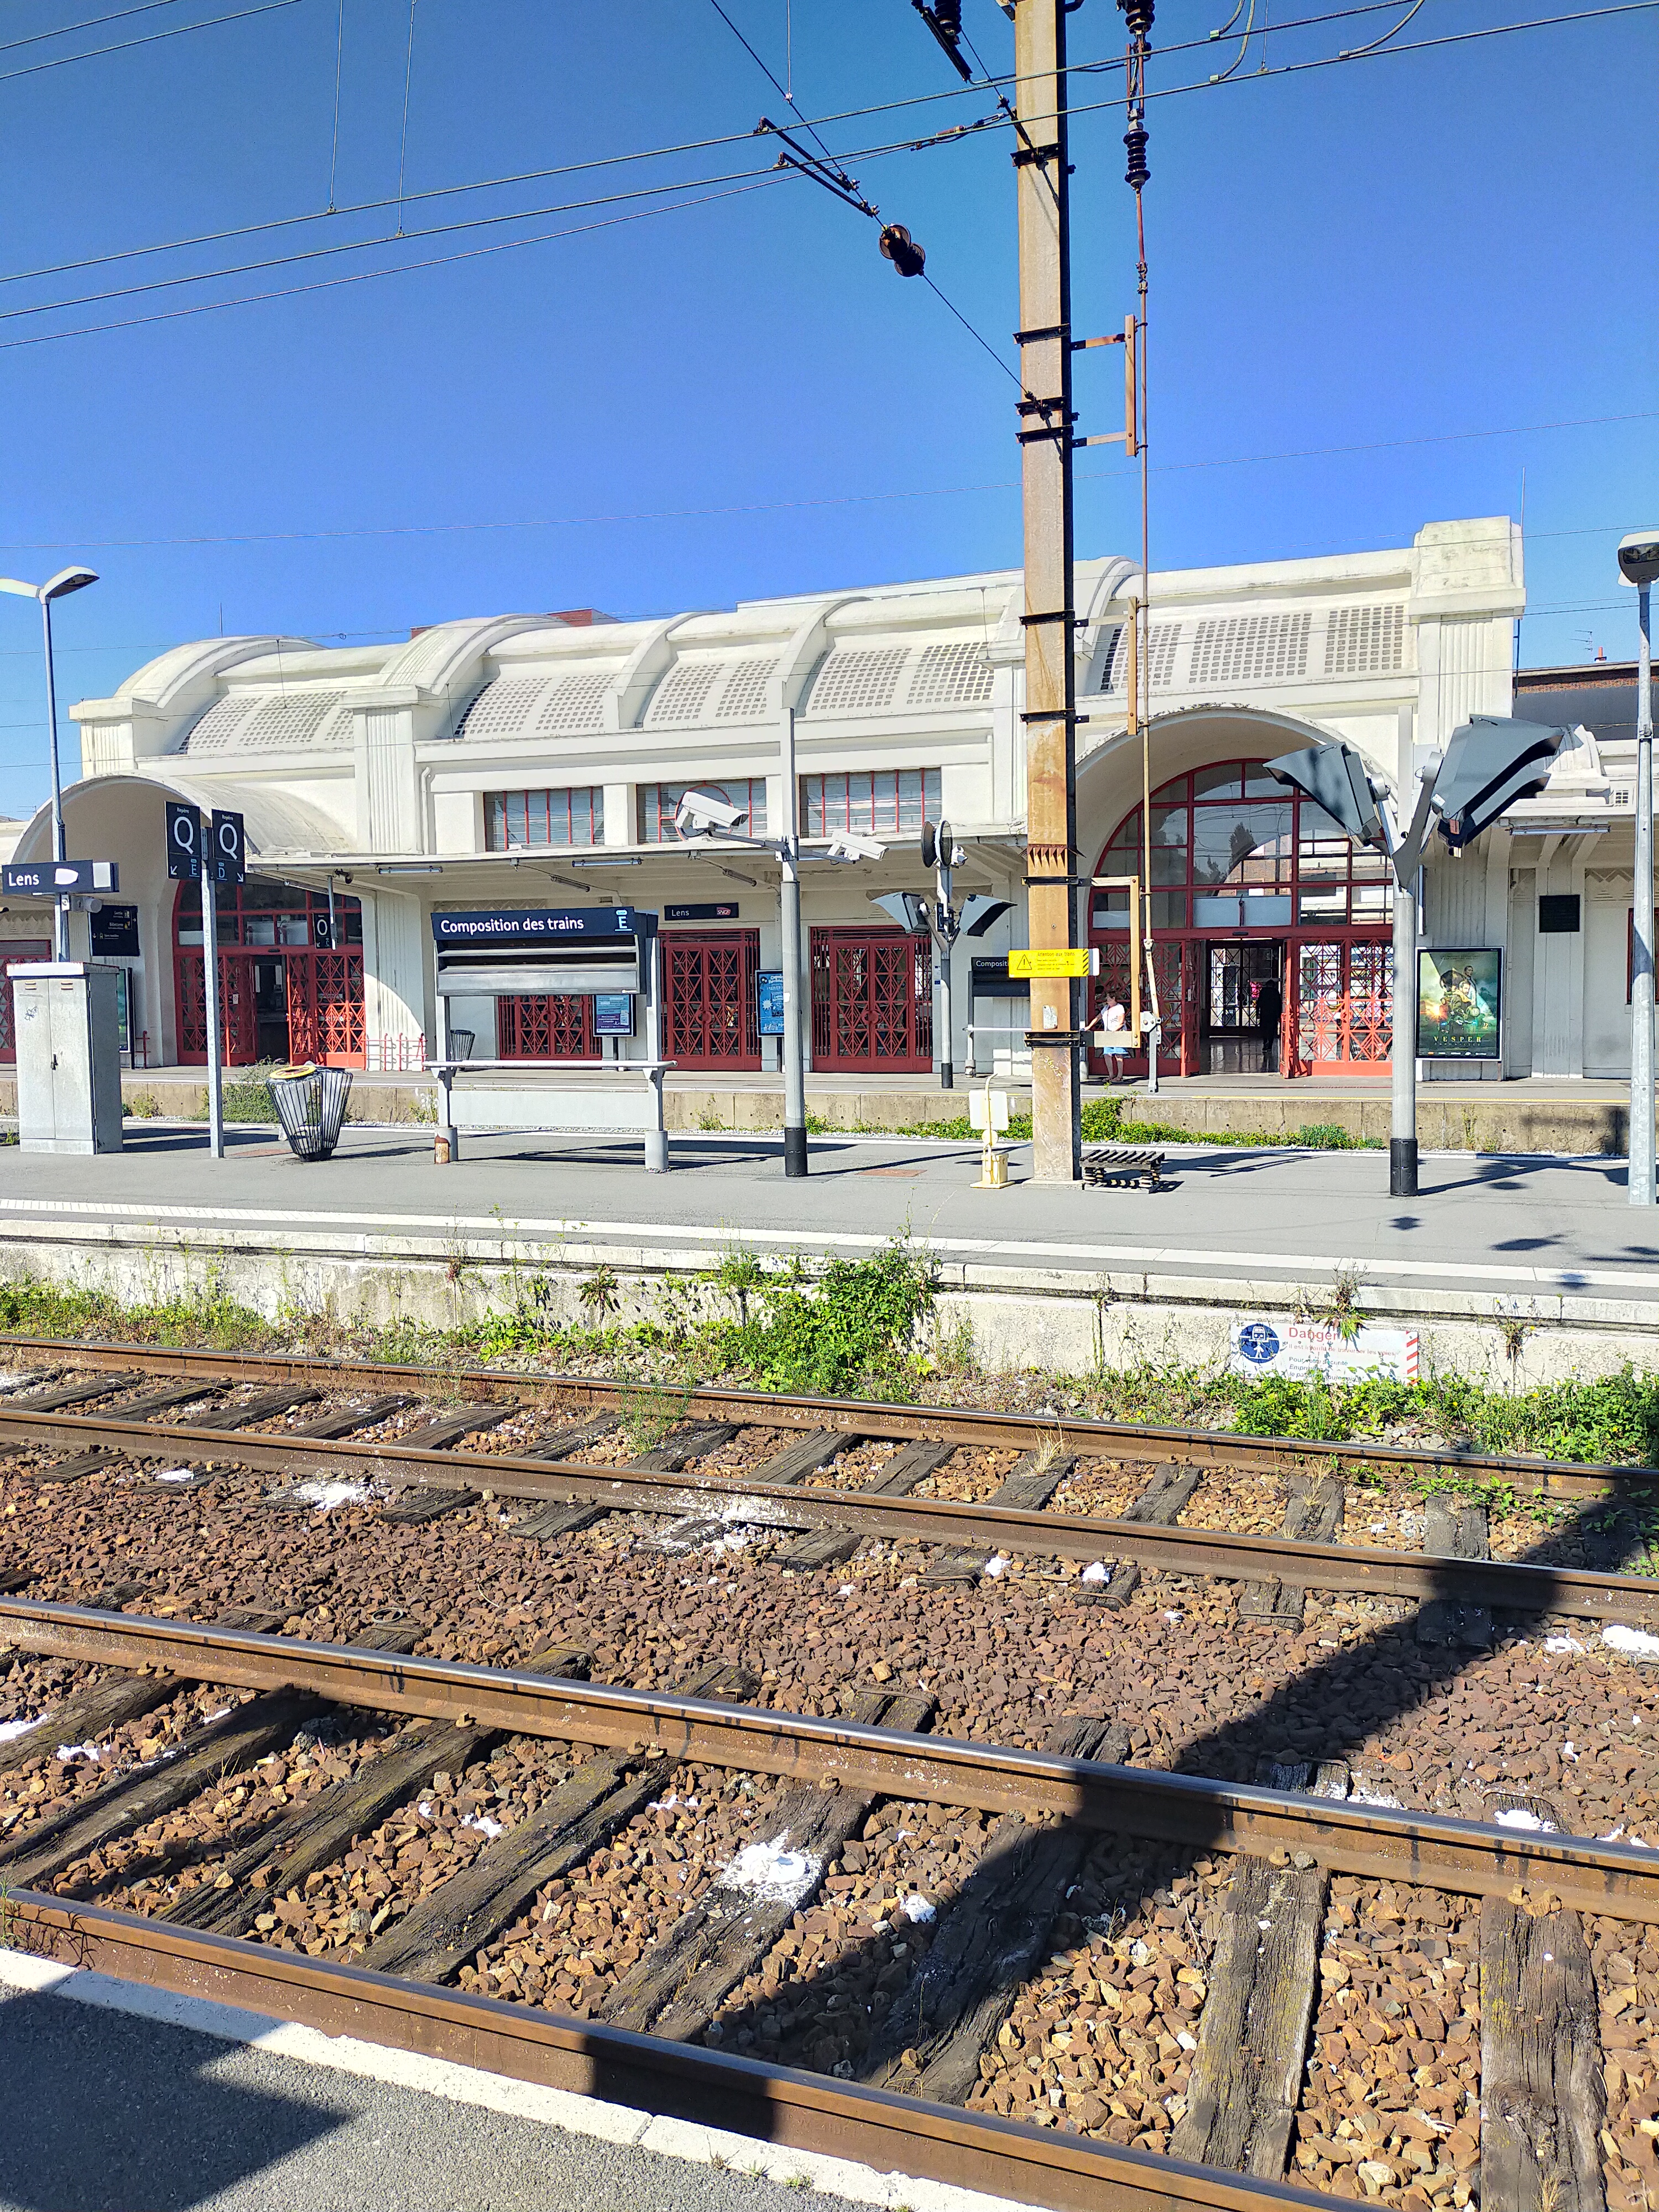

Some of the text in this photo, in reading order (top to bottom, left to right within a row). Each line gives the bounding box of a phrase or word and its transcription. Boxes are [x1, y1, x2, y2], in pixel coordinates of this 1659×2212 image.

[174, 816, 194, 855] Q
[220, 823, 238, 860] Q
[191, 864, 197, 875] E
[218, 867, 225, 878] D
[8, 872, 39, 886] Lens
[441, 915, 583, 935] Composition des trains
[618, 916, 628, 928] E
[1289, 1327, 1338, 1342] Danger
